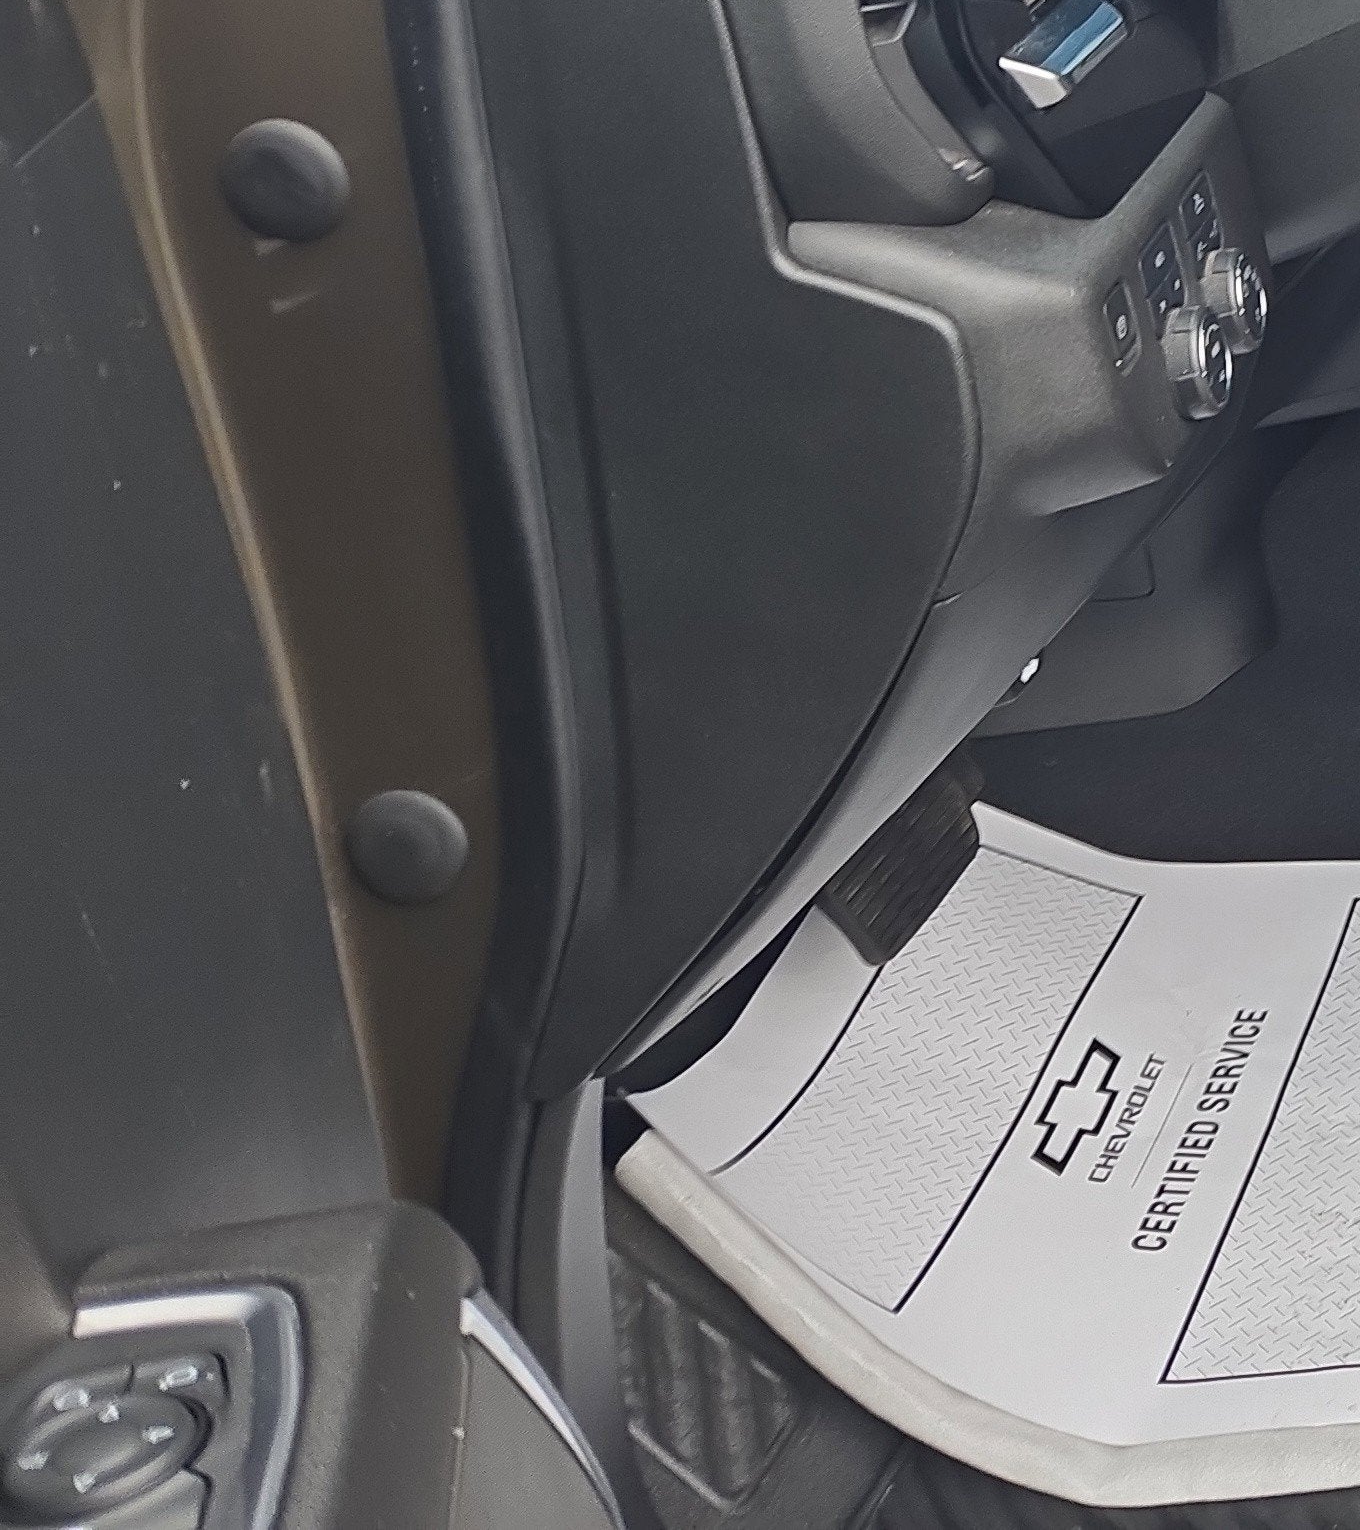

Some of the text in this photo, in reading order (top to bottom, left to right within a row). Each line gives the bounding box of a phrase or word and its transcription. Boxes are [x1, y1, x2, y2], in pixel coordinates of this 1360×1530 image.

[1087, 1051, 1167, 1184] CHEVROLET
[1131, 1008, 1270, 1252] CERTIFIED SERVICE
